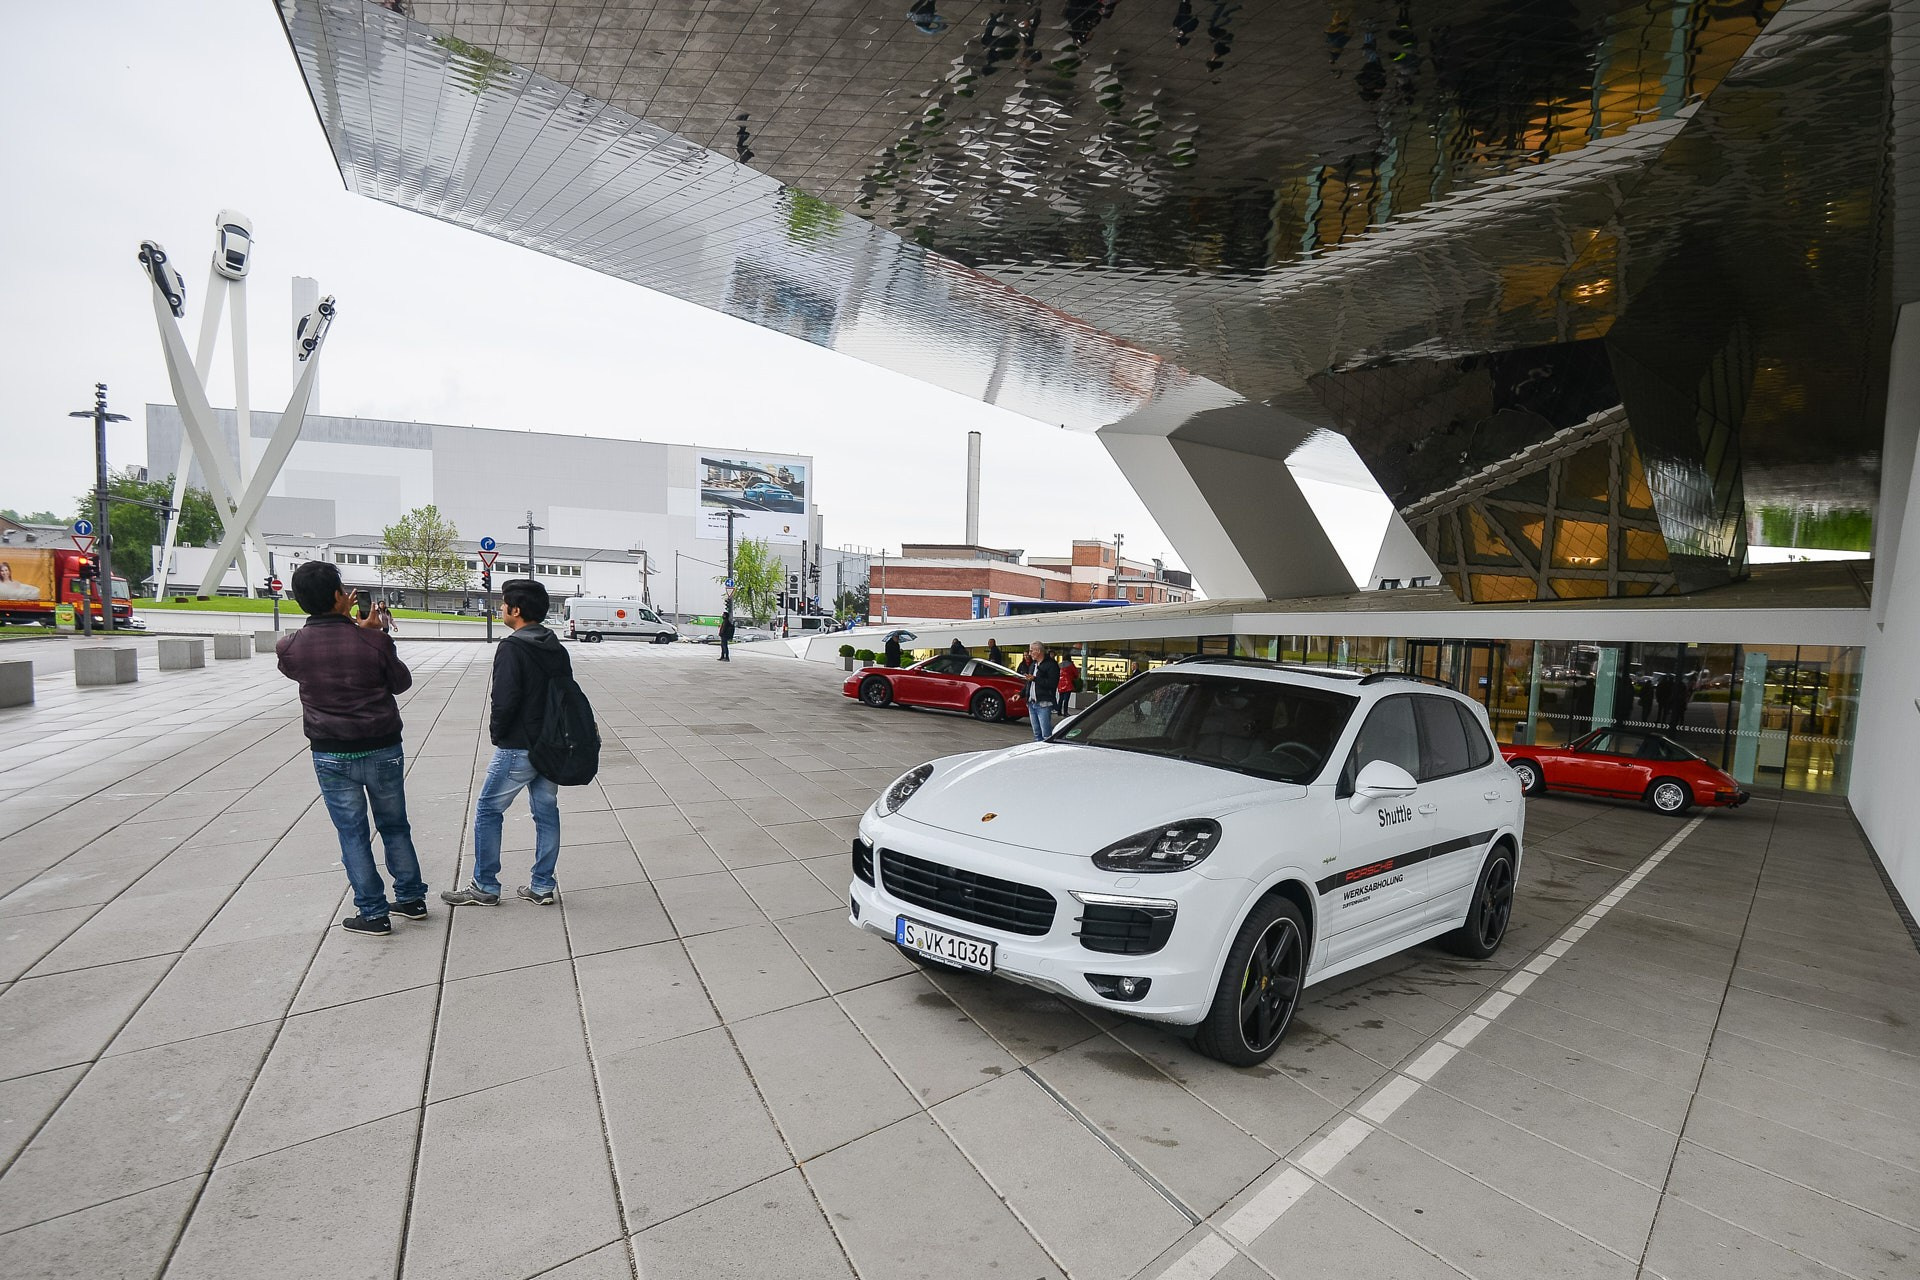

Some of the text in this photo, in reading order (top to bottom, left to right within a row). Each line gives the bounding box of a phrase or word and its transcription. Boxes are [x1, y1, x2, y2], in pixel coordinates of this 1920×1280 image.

[1378, 805, 1412, 828] Shuttle
[1345, 860, 1394, 881] PORSCHE
[1343, 874, 1404, 901] WERKSABHOLUNG
[906, 925, 915, 945] S
[925, 931, 944, 955] VK
[948, 939, 989, 966] 1036
